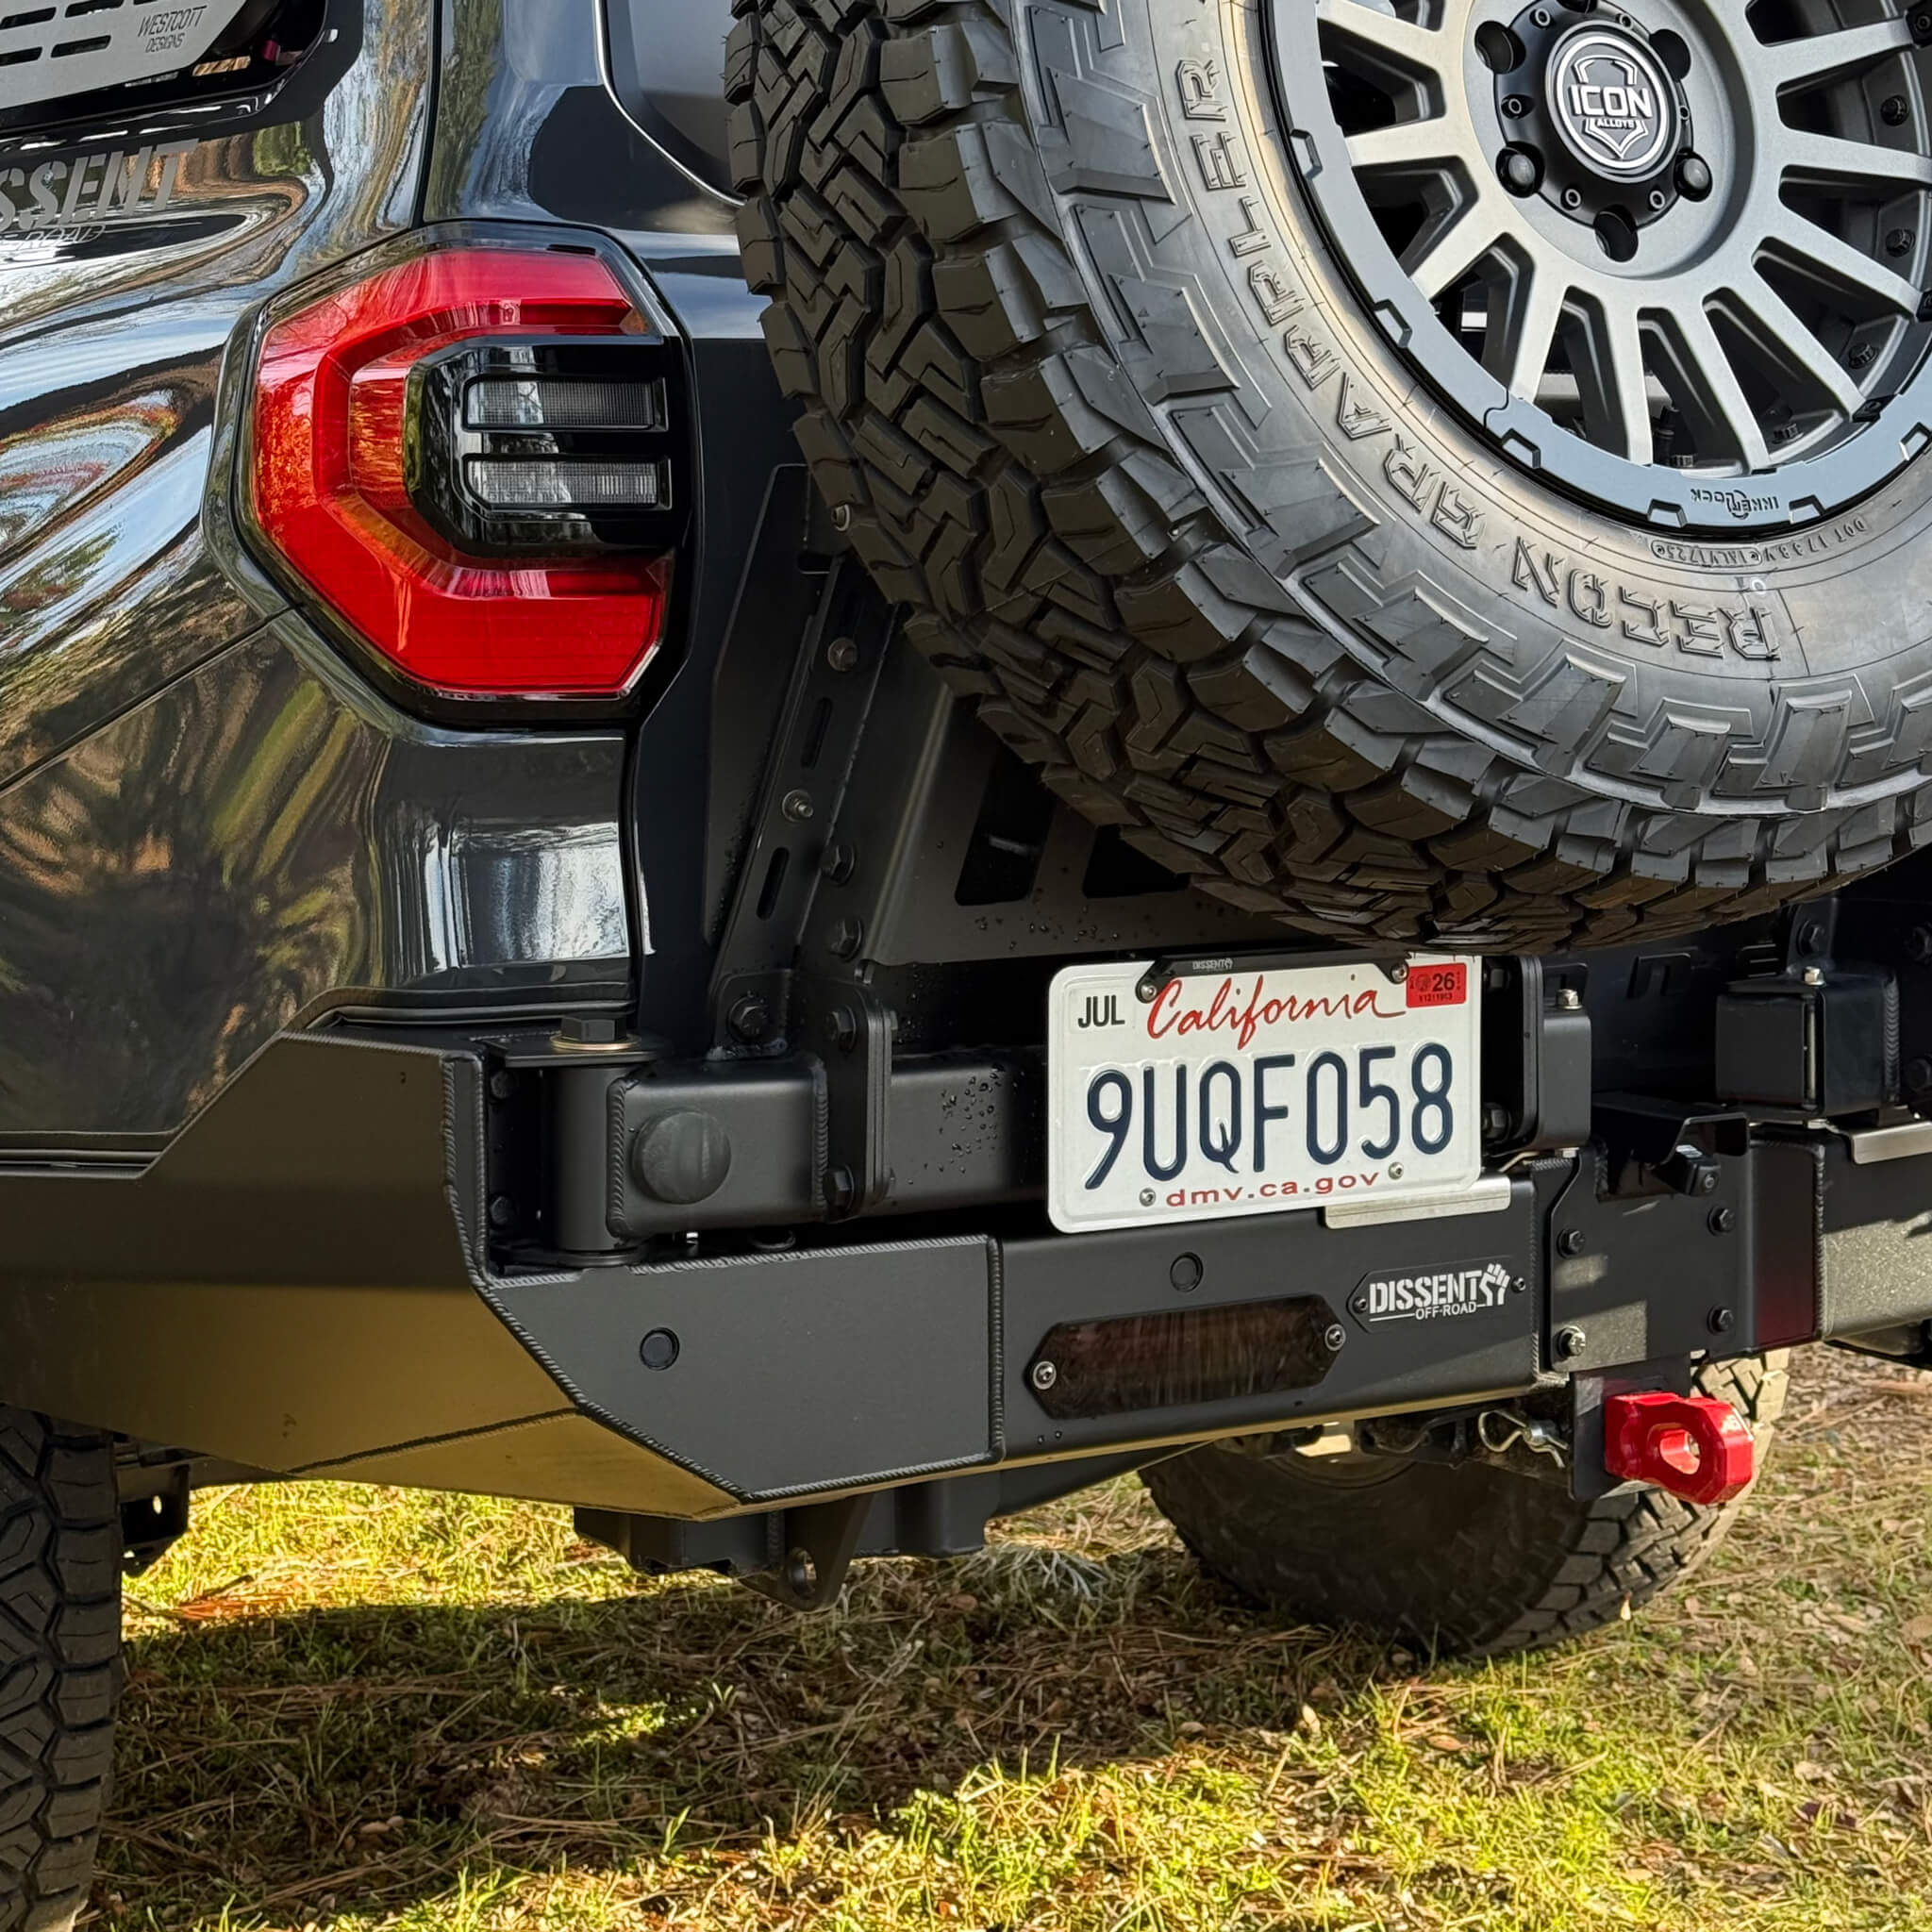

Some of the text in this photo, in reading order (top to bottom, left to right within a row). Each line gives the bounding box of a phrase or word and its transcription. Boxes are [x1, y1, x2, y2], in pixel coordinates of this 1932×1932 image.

[138, 5, 208, 37] WESTCOTT
[145, 33, 185, 53] DESIGNS
[1570, 84, 1652, 118] ICON
[1175, 58, 1781, 661] RECON GRAPPLER
[1432, 973, 1455, 991] 26
[1077, 974, 1406, 1050] JUL California
[1085, 1042, 1454, 1190] 9UQF058
[1166, 1172, 1380, 1208] dmv.ca.gov
[1370, 1270, 1482, 1314] DISSENT
[1415, 1300, 1477, 1321] OFF-ROAD
